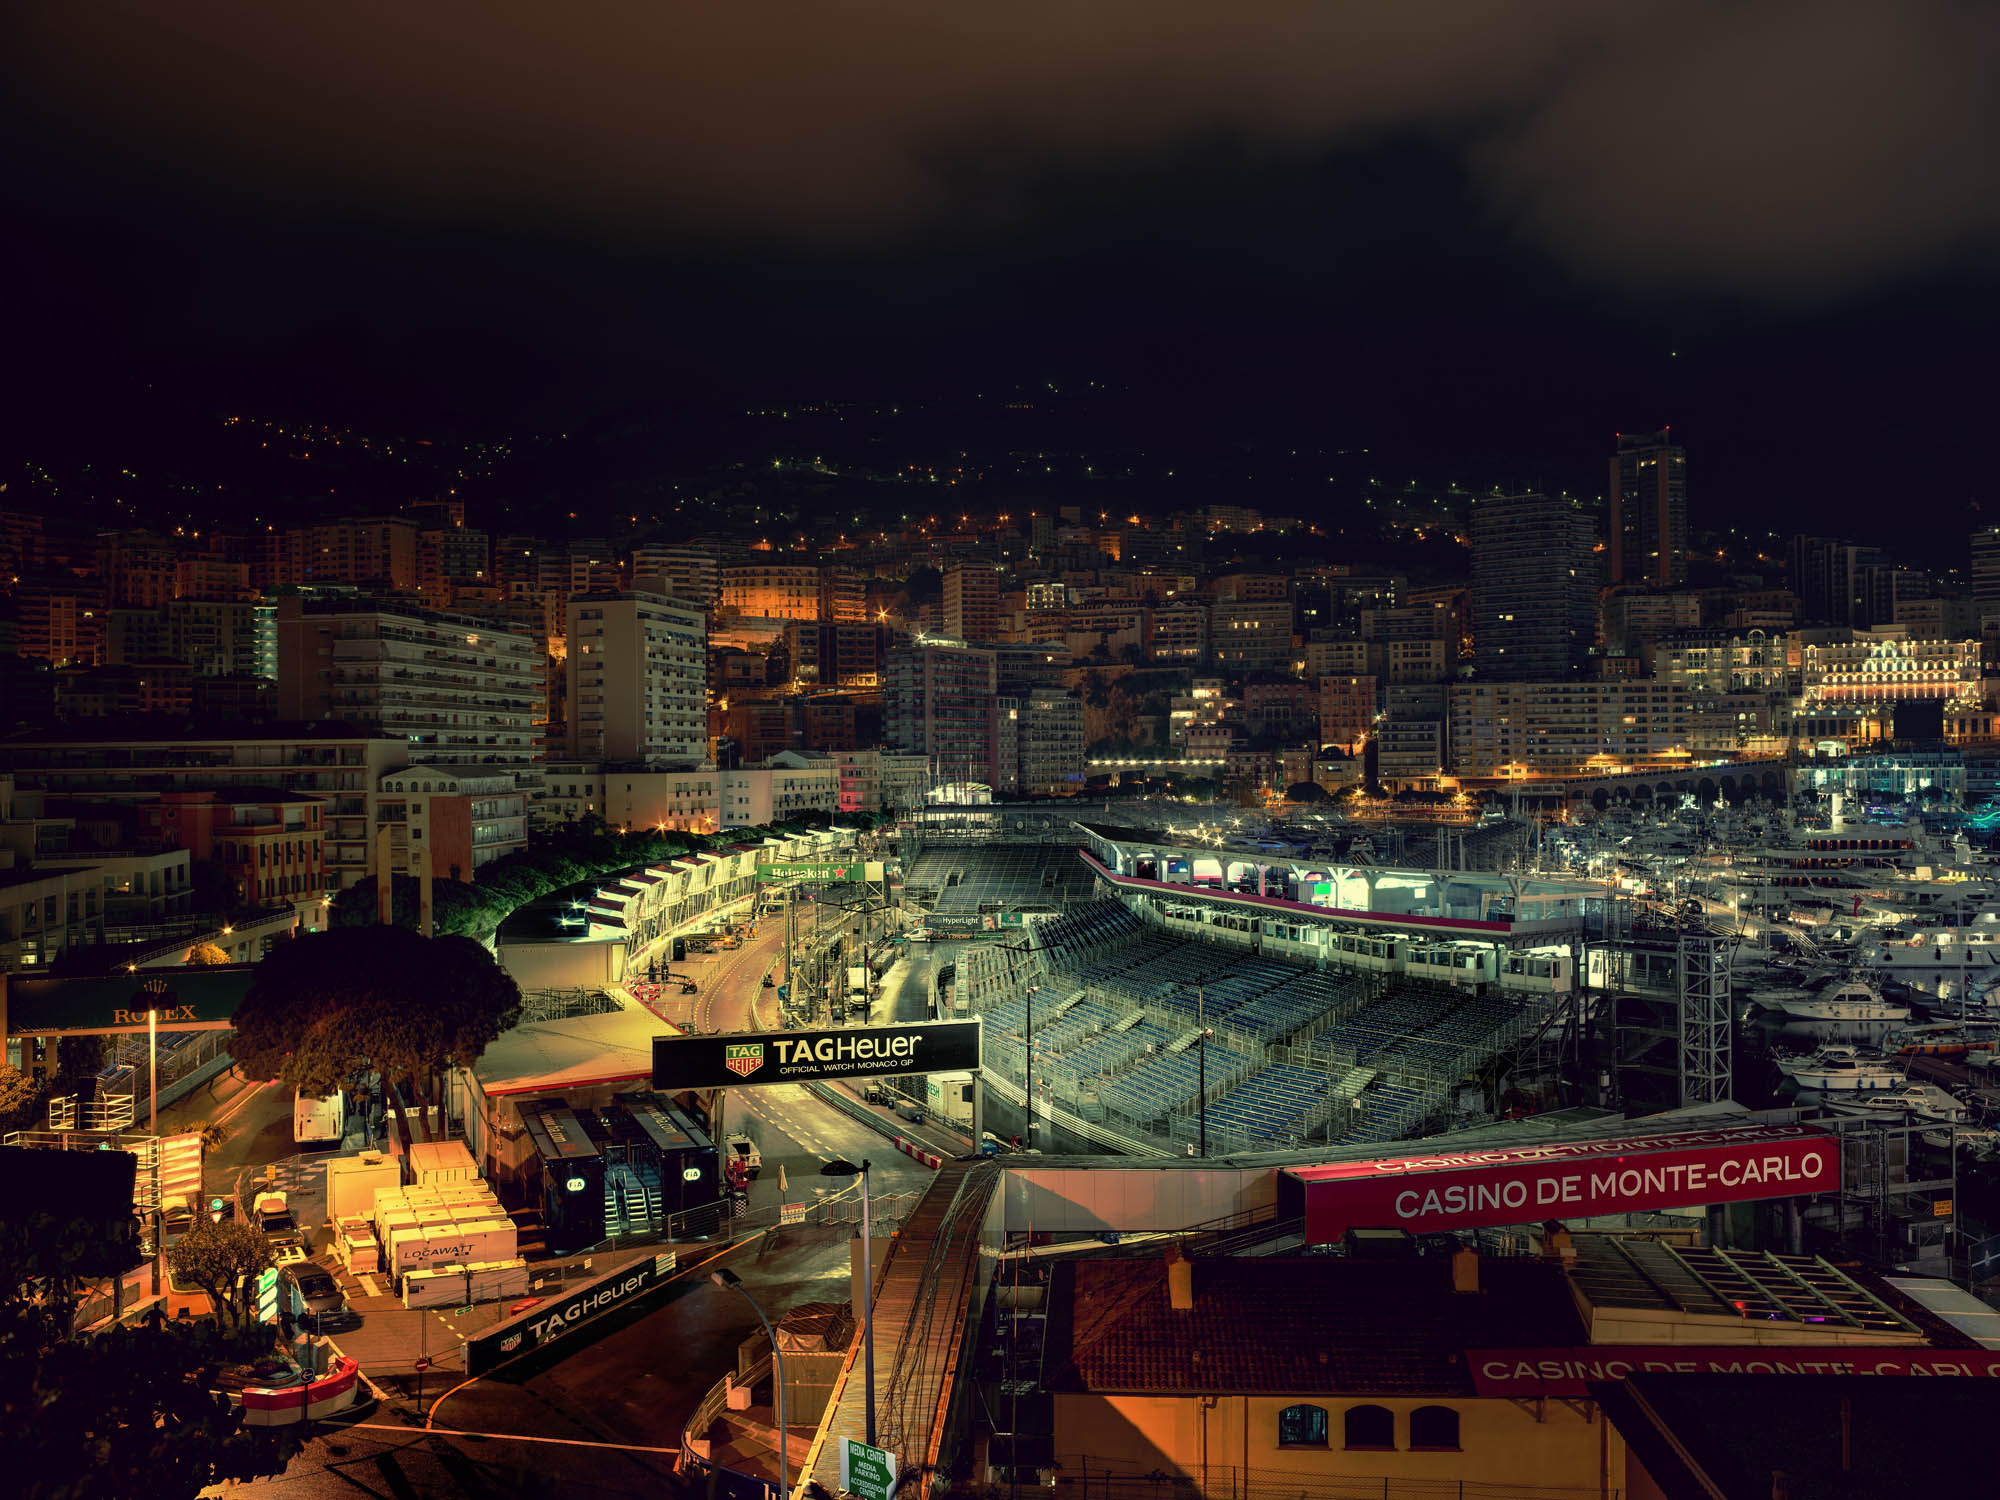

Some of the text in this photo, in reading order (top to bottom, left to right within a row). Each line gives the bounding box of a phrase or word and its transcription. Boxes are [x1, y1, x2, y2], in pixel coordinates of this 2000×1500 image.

[772, 868, 830, 879] Heineken
[113, 1004, 198, 1024] ROEX
[729, 1046, 760, 1057] TAG
[728, 1059, 761, 1073] HEUER
[780, 1059, 914, 1074] OFFICIAL WATCH MONACO GP
[1395, 1152, 1823, 1218] CASINO DE MONTE-CARLO
[404, 1244, 475, 1259] LOCAWATT
[1482, 1361, 1636, 1380] CASINO
[850, 1442, 885, 1465] MEDIA CENTRE
[855, 1466, 881, 1481] PARKING
[858, 1460, 877, 1473] MEDIA
